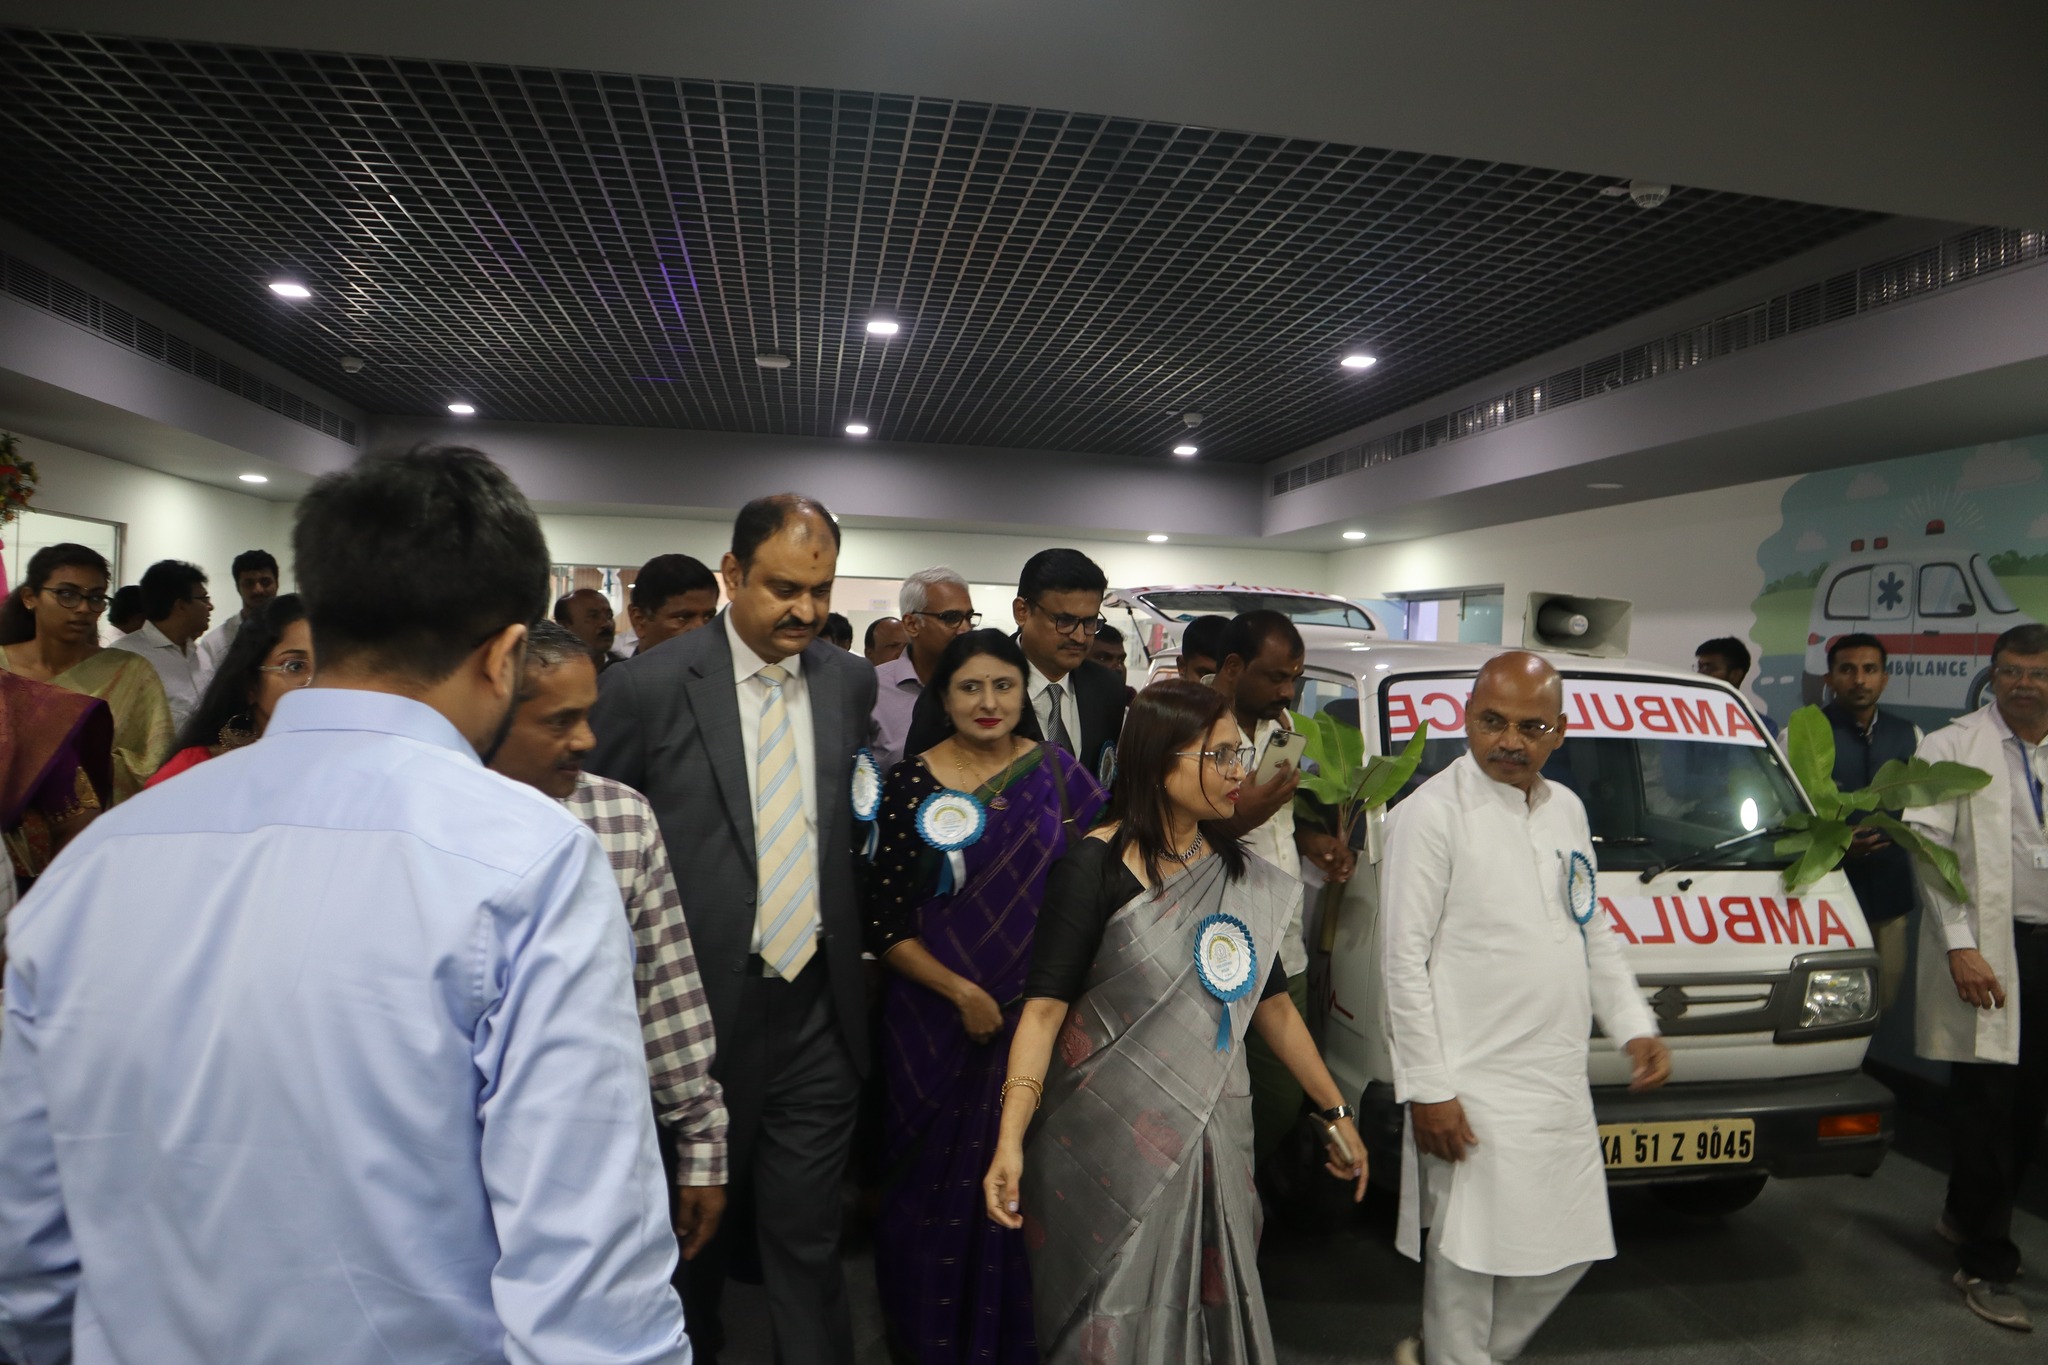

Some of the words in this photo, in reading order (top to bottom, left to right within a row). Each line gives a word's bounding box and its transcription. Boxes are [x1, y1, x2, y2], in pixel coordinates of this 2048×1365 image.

[1885, 661, 1968, 676] MBULANCE
[1635, 1133, 1660, 1163] 51
[1671, 1132, 1685, 1162] Z
[1696, 1130, 1752, 1160] 9045
